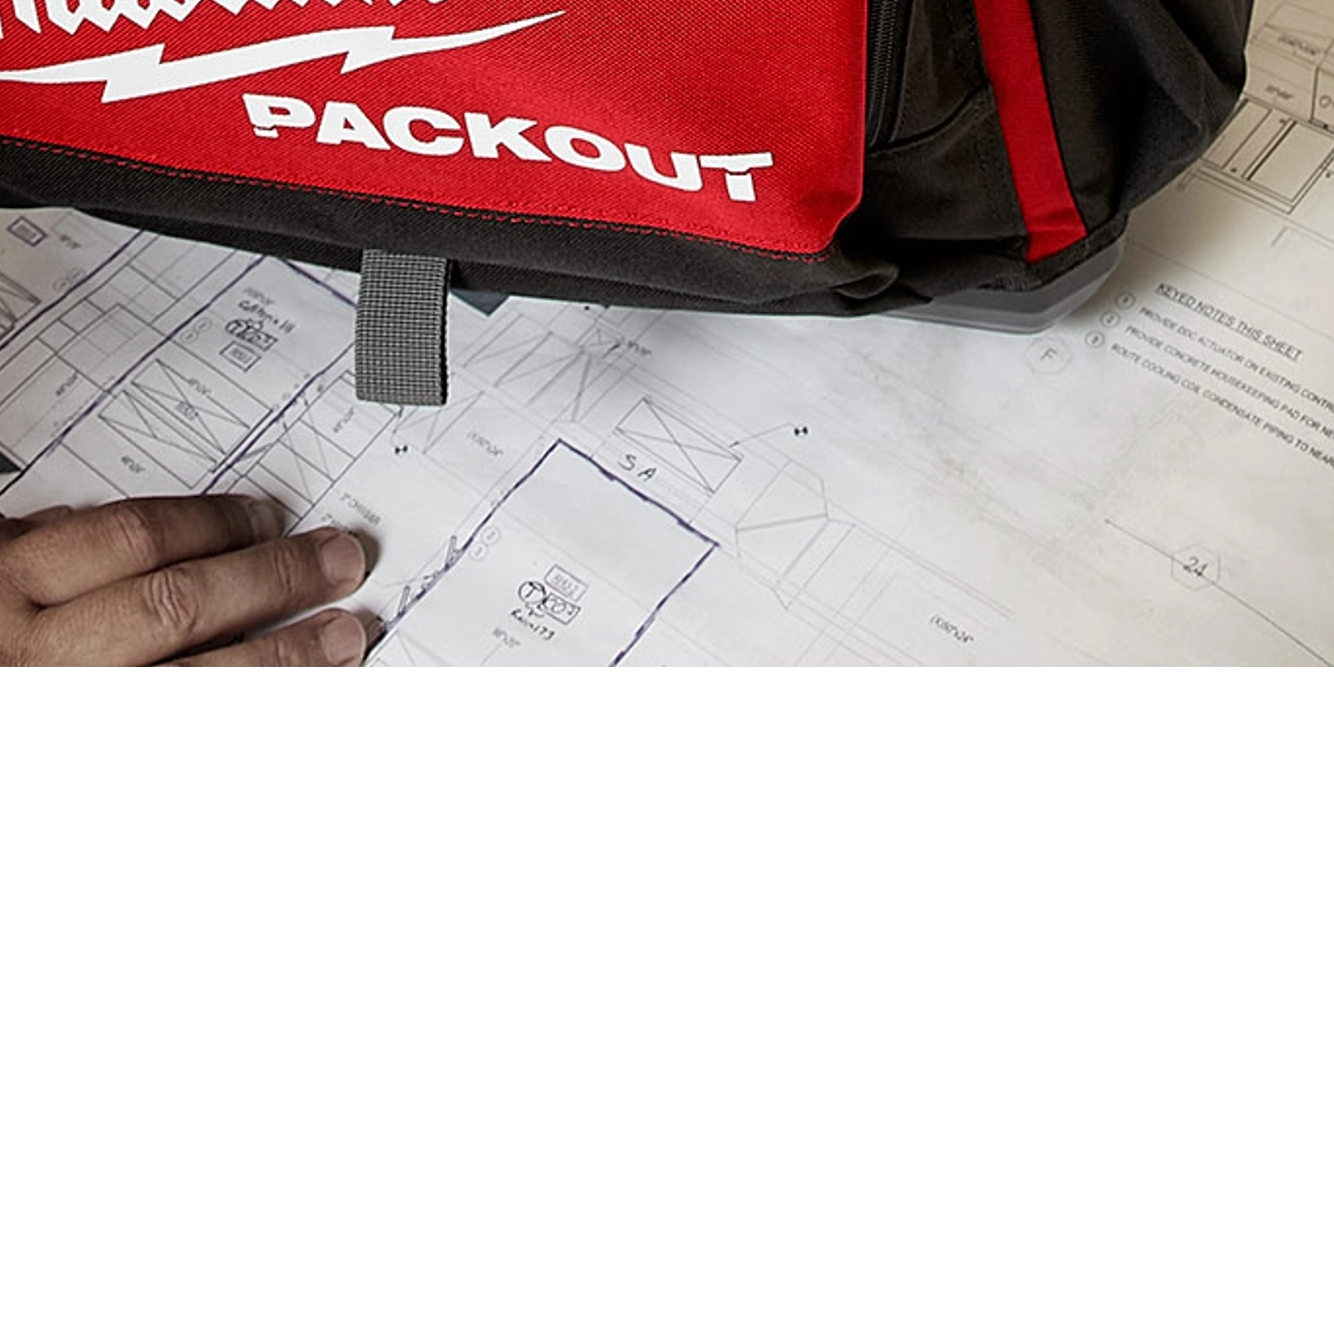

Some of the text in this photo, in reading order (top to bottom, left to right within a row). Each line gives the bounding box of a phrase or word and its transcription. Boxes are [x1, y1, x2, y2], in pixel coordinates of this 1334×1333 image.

[241, 92, 773, 202] PACKOUT
[1138, 306, 1177, 330] PROVIDE
[1198, 335, 1246, 364] ACTUATOR
[1258, 366, 1301, 394] EXISTING
[1157, 283, 1304, 360] KEYED NOTES THIS SHEET
[1111, 343, 1142, 365] ROUTE
[1141, 358, 1182, 385] COOLING
[1201, 389, 1263, 430] CONDENSATE
[1261, 421, 1295, 445] PIPING
[1125, 325, 1163, 349] PROVIDE
[1164, 344, 1213, 373] CONCRETE
[1209, 367, 1280, 410] HOUSEKEEPING
[1280, 404, 1301, 421] PAD
[1300, 414, 1321, 433] FOR
[1182, 555, 1208, 577] 24
